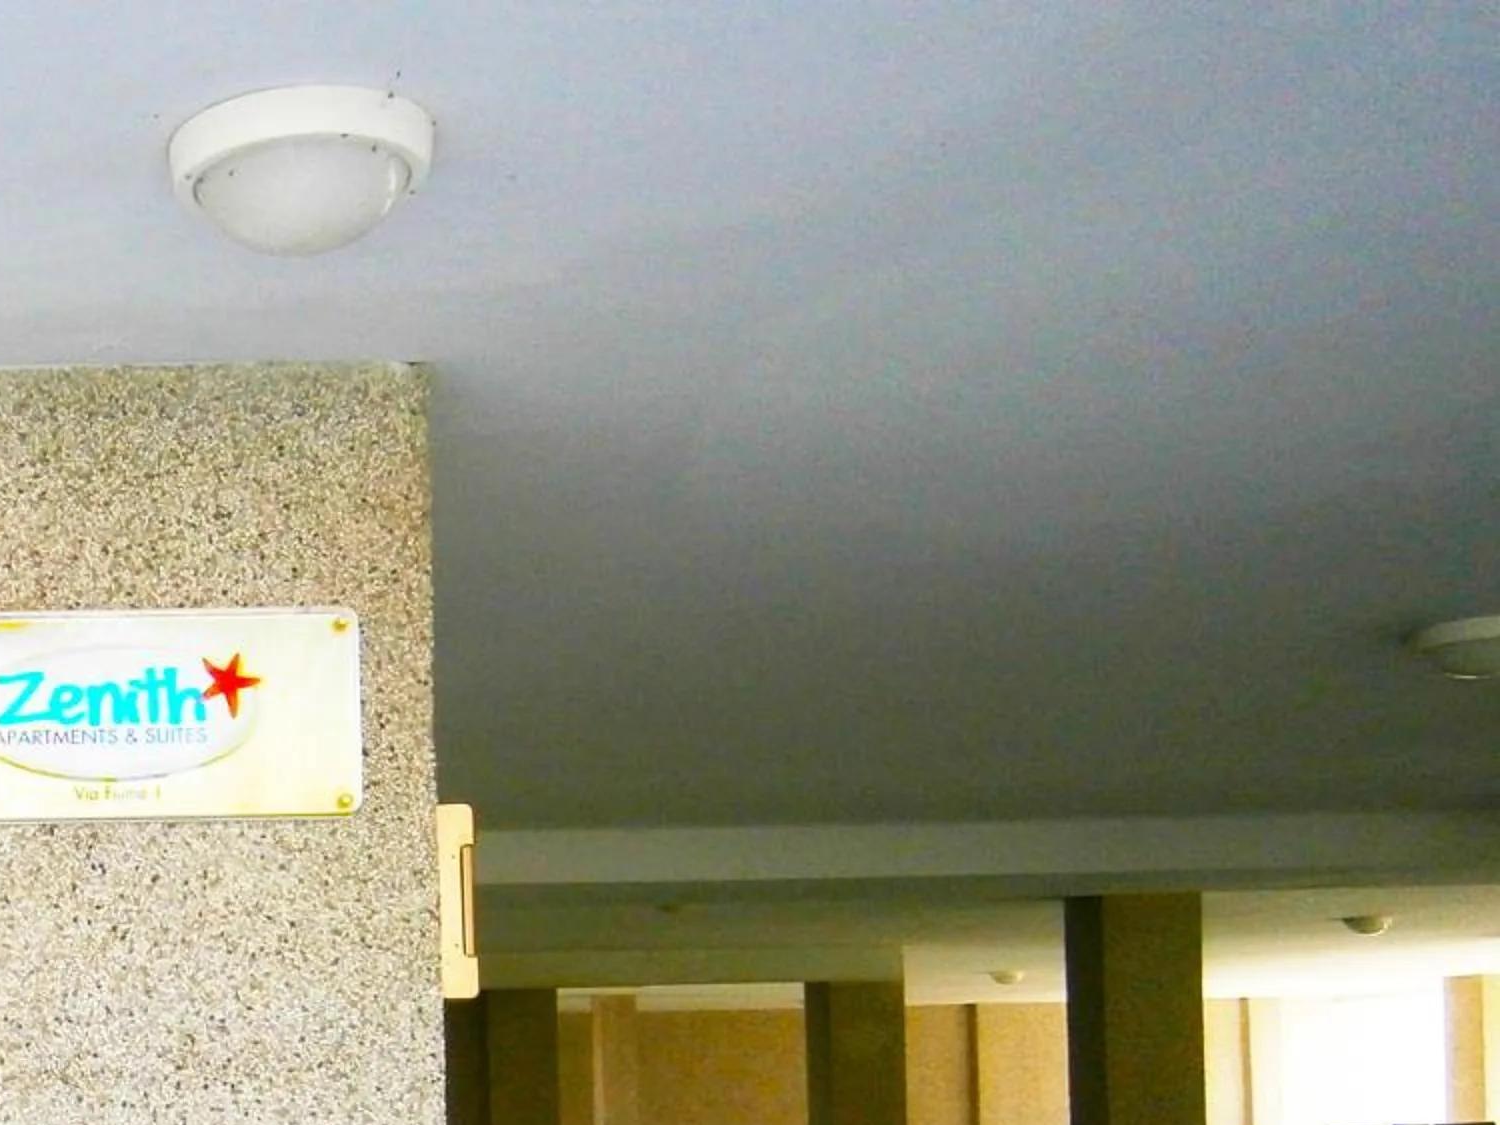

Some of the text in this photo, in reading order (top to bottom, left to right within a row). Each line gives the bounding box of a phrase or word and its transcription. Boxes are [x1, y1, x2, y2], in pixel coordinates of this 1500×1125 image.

[125, 728, 138, 744] &
[145, 727, 207, 743] SUITES
[73, 785, 99, 801] Via
